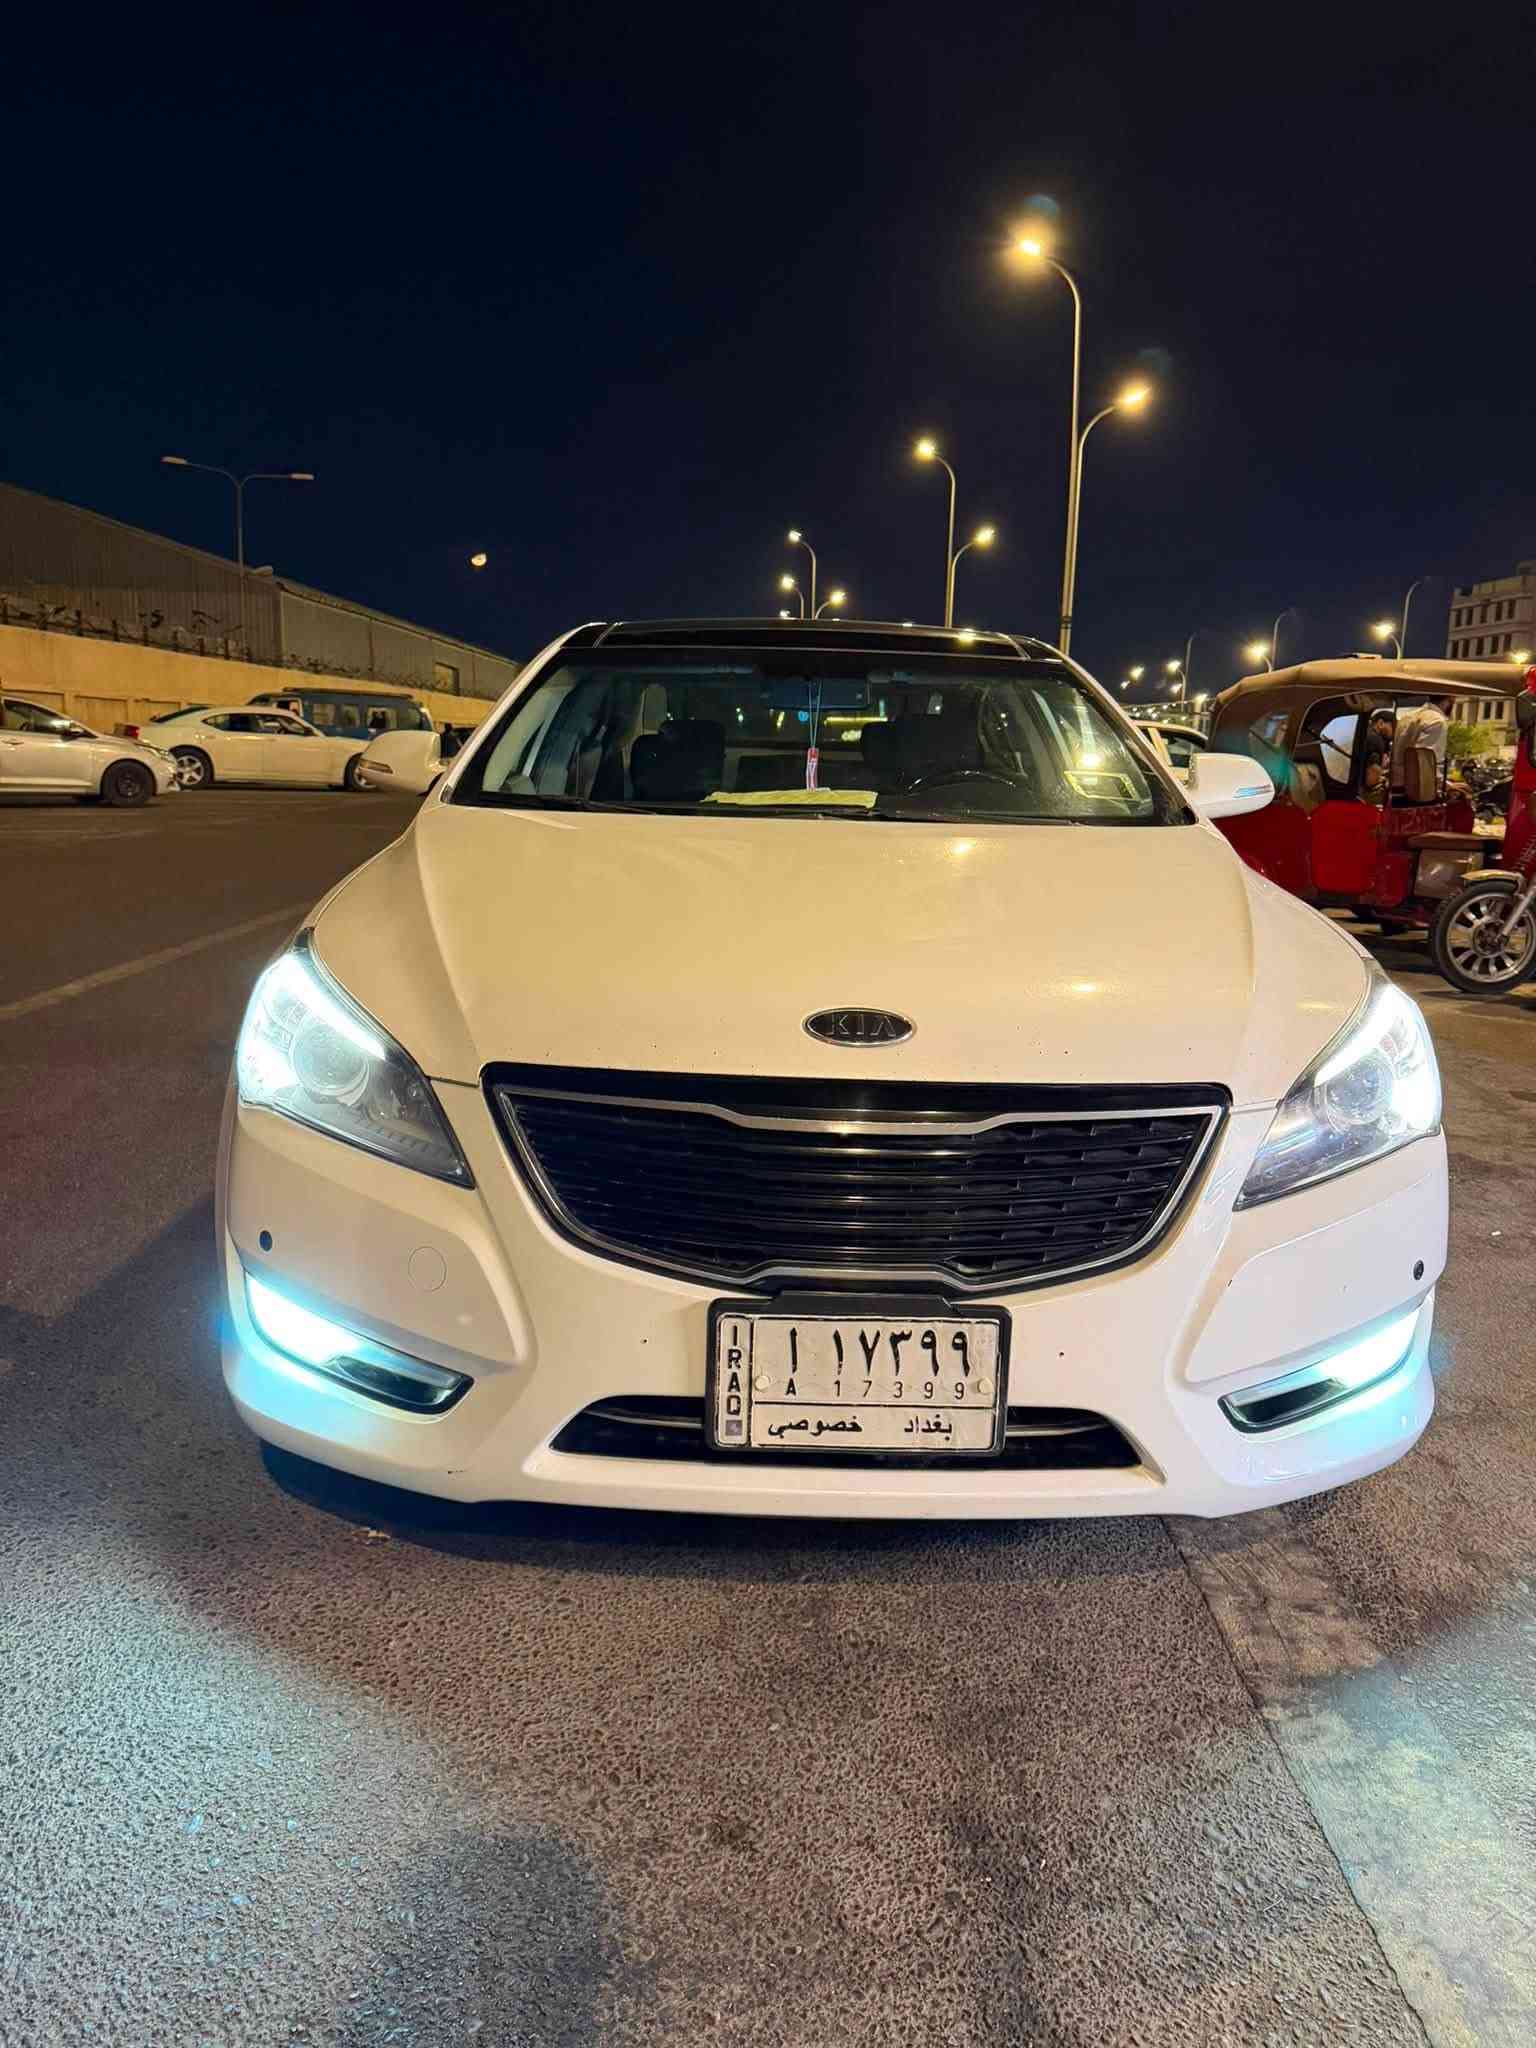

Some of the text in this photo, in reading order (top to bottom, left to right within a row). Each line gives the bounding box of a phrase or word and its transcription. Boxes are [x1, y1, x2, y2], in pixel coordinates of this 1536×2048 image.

[825, 1013, 897, 1037] KIA
[832, 1328, 970, 1377] ١٧٣٩٩
[727, 1325, 742, 1416] IRAQ
[785, 1378, 965, 1400] A 17399
[904, 1414, 953, 1440] بغداد
